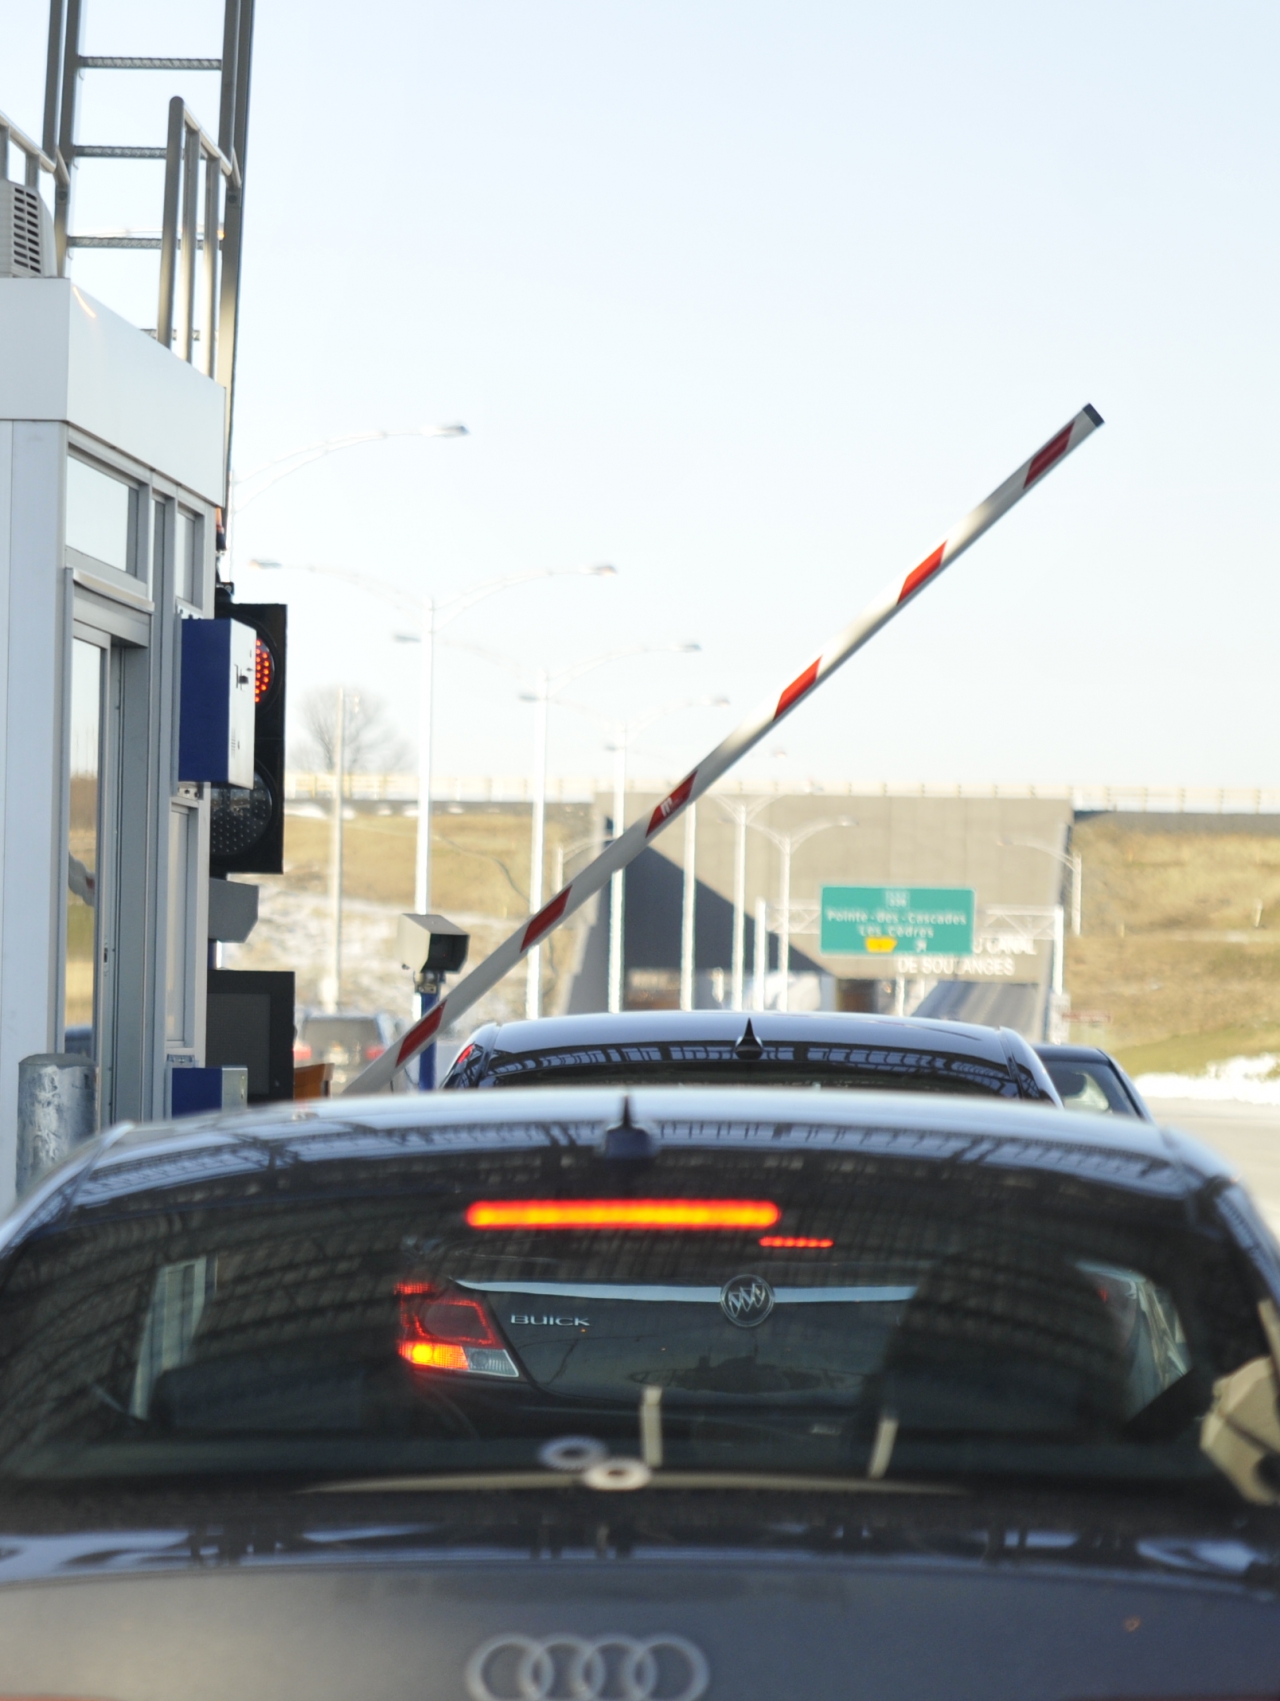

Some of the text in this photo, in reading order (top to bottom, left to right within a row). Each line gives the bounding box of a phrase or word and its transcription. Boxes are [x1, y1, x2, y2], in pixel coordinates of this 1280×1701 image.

[858, 924, 882, 937] Les
[897, 955, 918, 974] DE
[510, 1314, 590, 1326] BUICK
